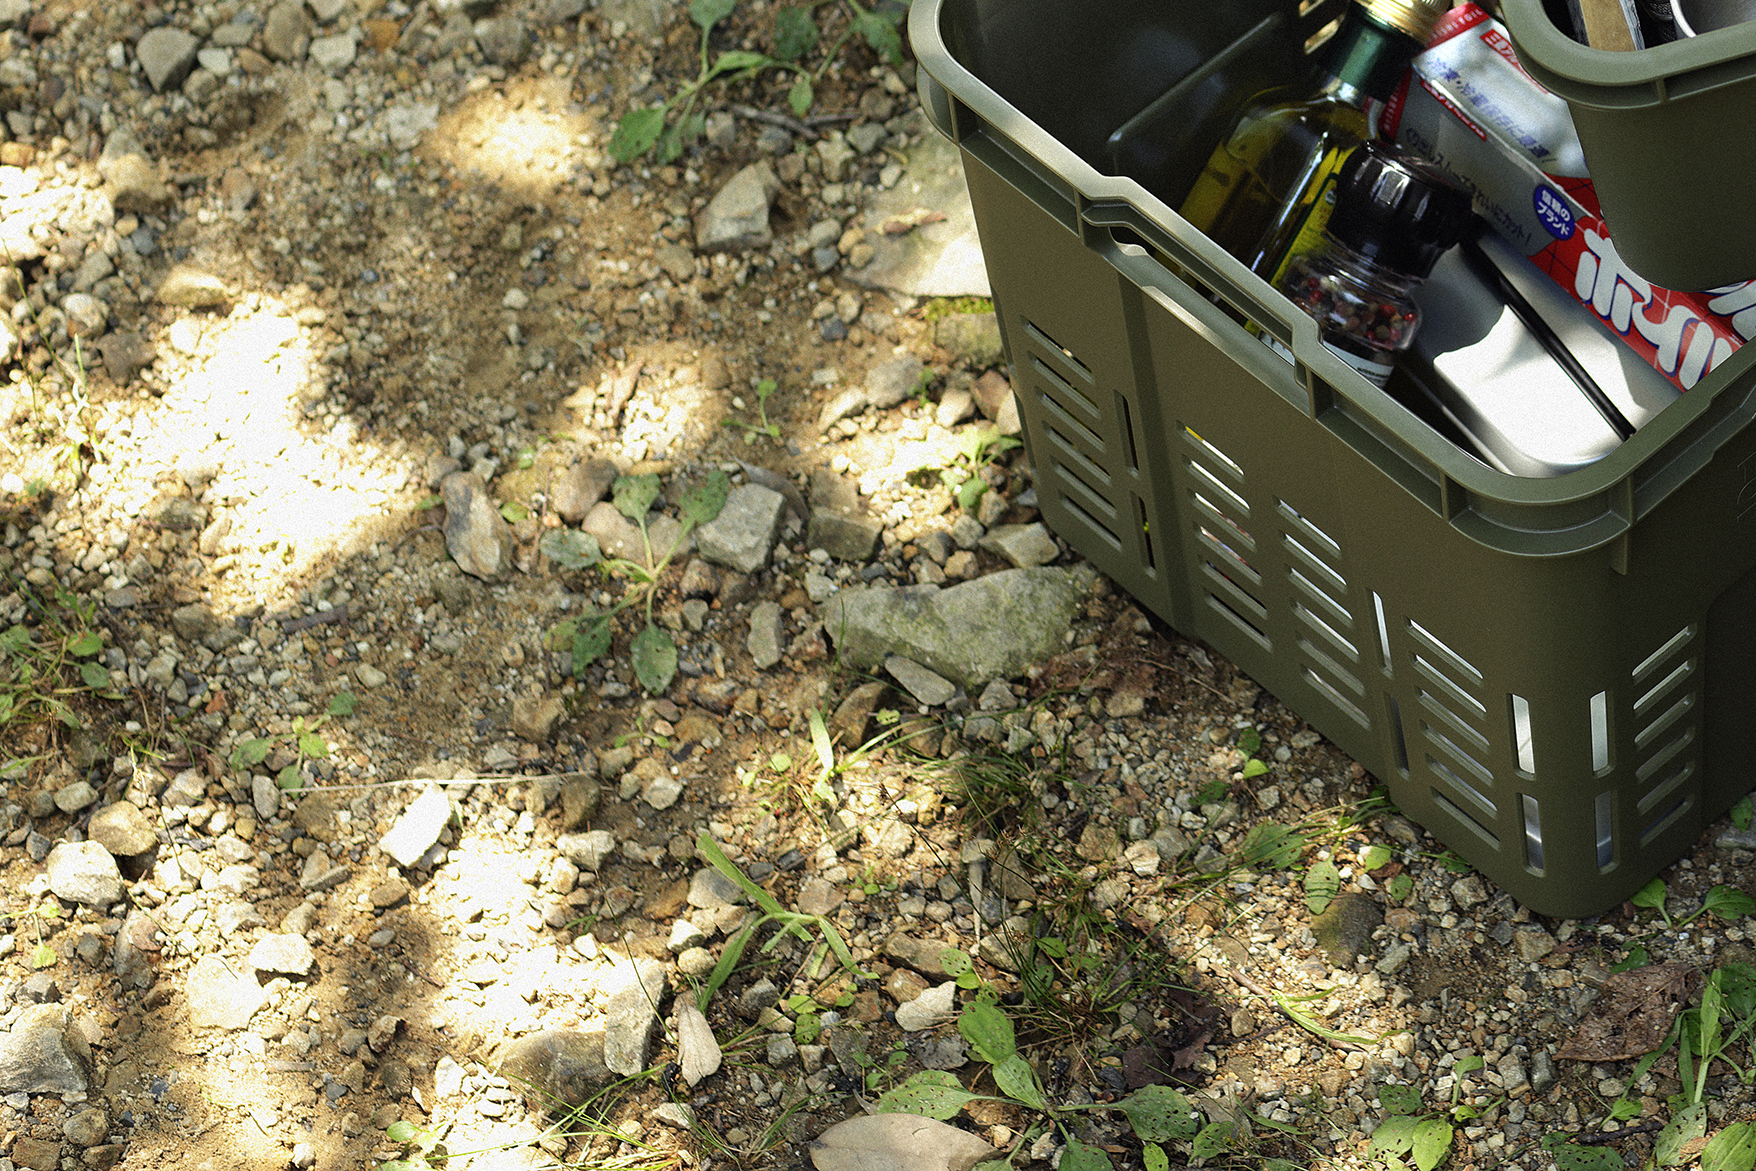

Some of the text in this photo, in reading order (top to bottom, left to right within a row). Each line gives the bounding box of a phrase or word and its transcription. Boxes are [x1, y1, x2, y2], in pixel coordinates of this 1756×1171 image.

[1457, 8, 1483, 26] FOIL
[1537, 200, 1570, 236] ブランド
[1541, 189, 1571, 222] 信頼の
